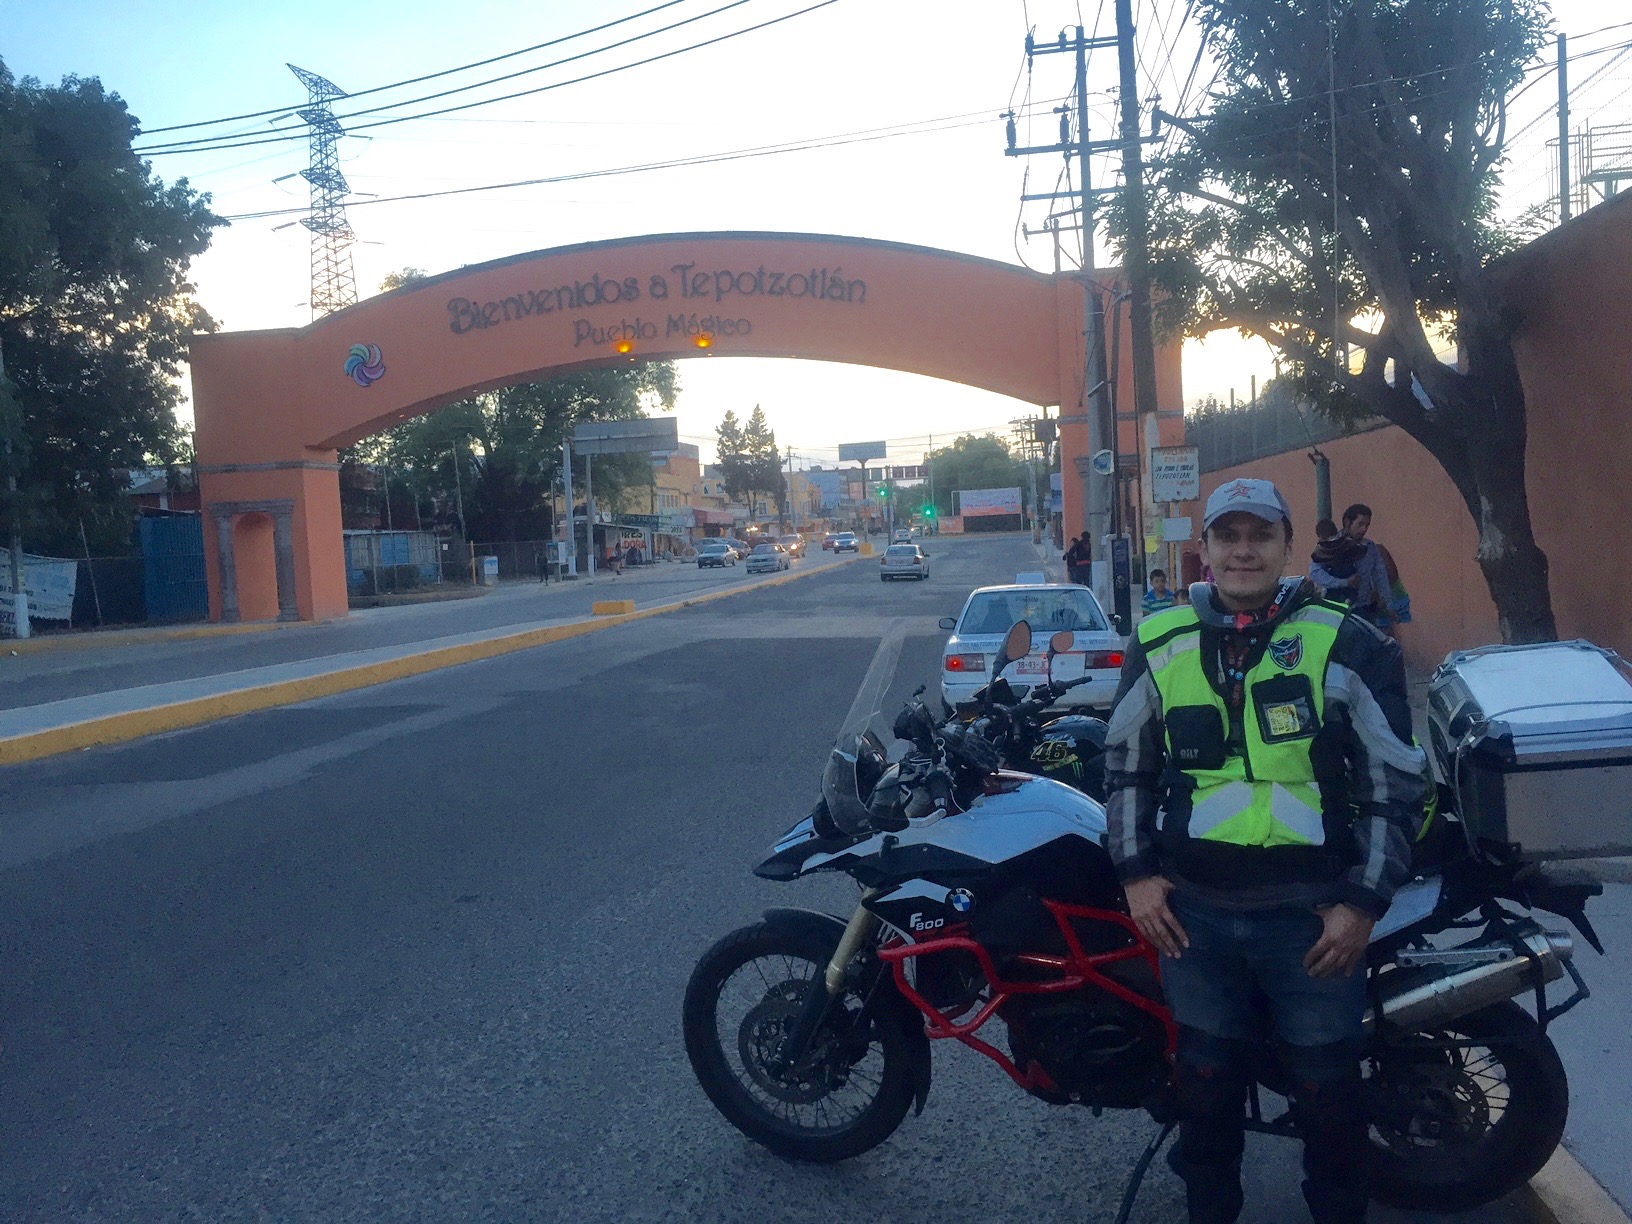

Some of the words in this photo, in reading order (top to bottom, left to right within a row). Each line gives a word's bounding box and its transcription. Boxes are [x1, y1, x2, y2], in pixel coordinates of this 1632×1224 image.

[447, 271, 640, 335] Bienvenidos
[649, 274, 668, 299] a
[670, 260, 867, 303] Tepotzotlán
[572, 316, 658, 348] Pueblo
[665, 312, 752, 340] Mágico
[1030, 740, 1067, 762] 46
